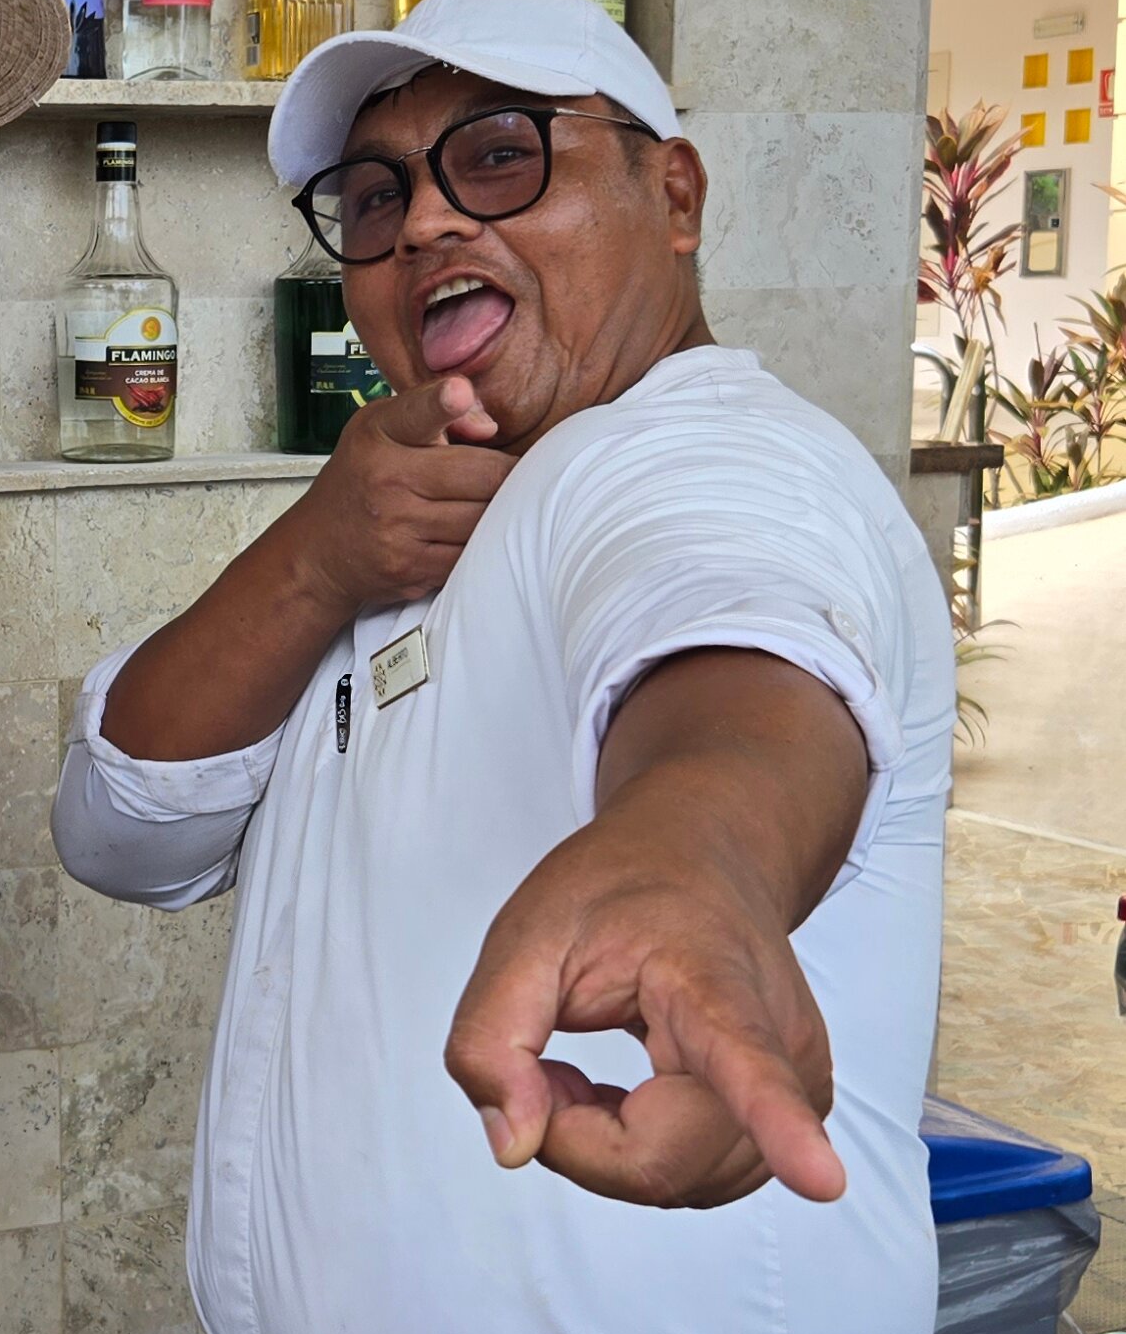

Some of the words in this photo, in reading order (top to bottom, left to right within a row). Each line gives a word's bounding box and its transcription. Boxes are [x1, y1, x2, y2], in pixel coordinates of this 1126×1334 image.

[111, 350, 176, 362] FLAMINGO
[134, 369, 156, 377] CREMA
[124, 377, 149, 385] CACAO
